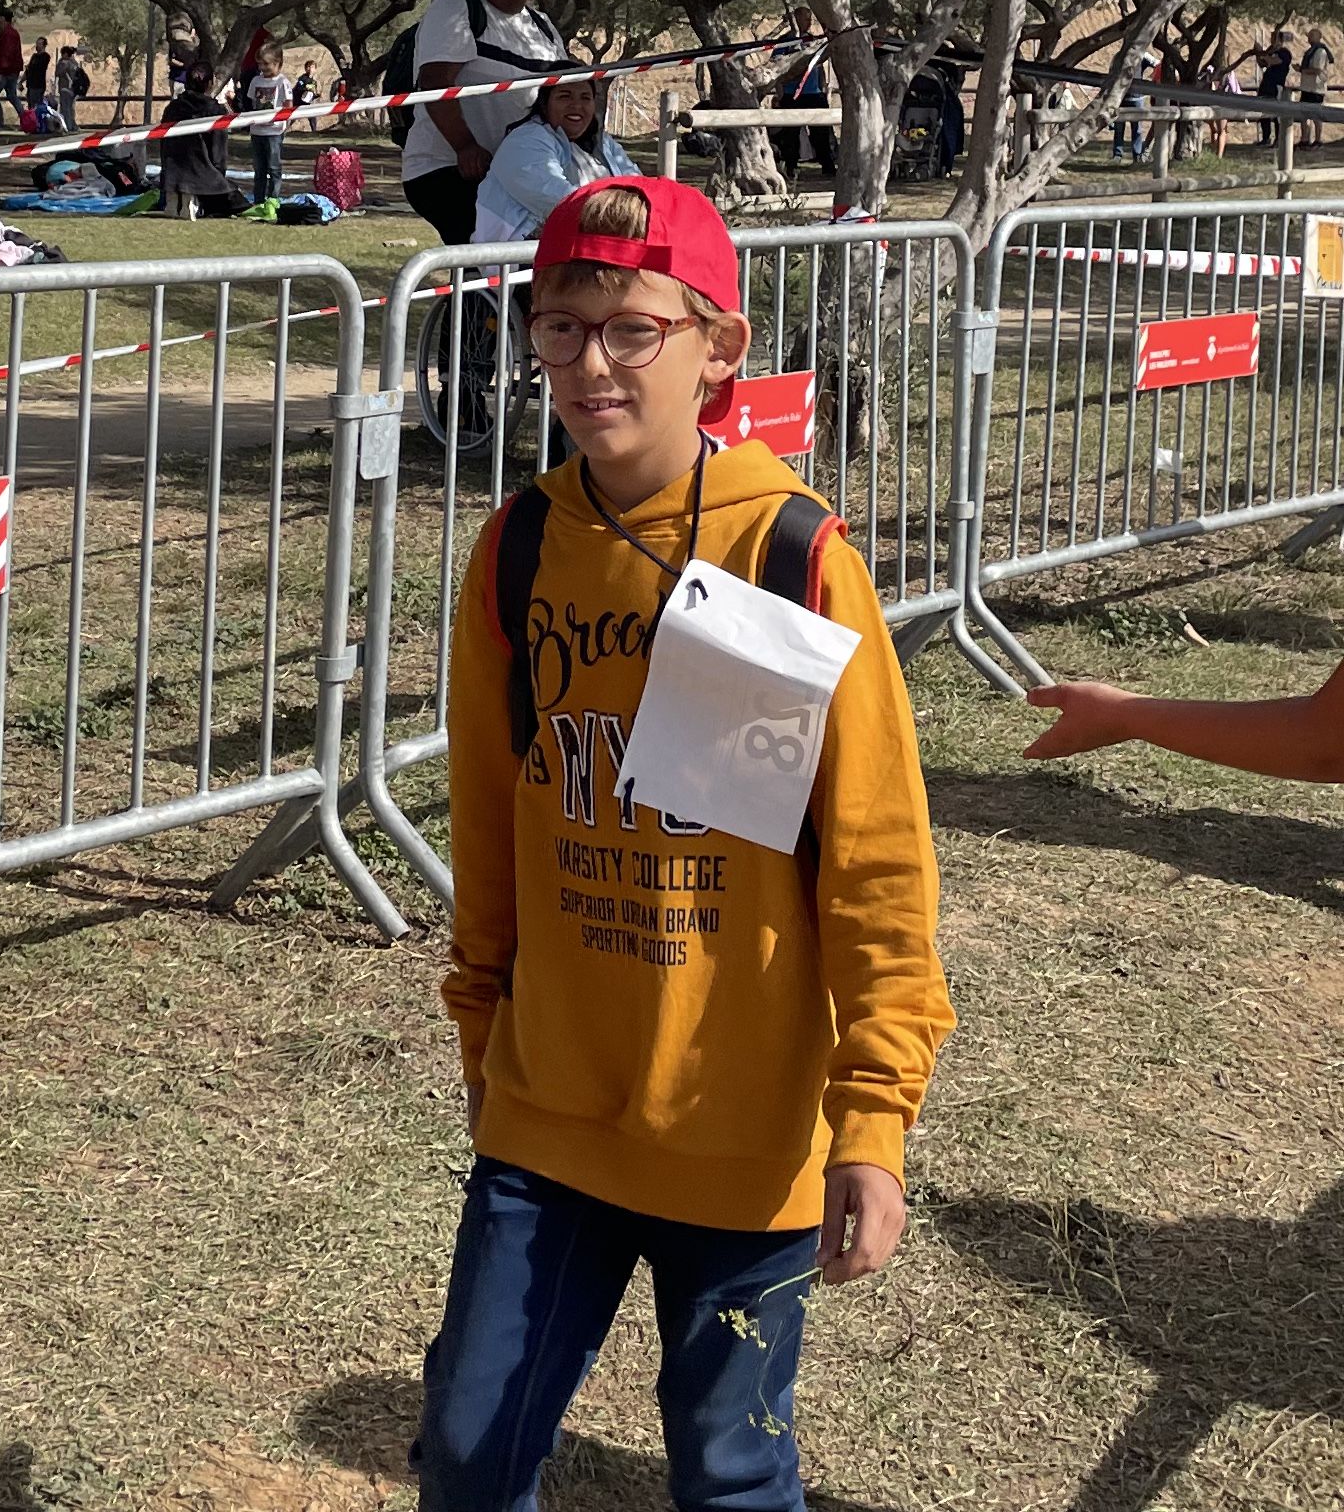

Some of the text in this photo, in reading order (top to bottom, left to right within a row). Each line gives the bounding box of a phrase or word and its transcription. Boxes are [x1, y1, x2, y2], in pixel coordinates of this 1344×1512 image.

[549, 709, 713, 837] NY
[555, 837, 728, 892] VARSITY COLLEGE
[666, 907, 720, 934] BRAND
[641, 937, 687, 967] GOODS
